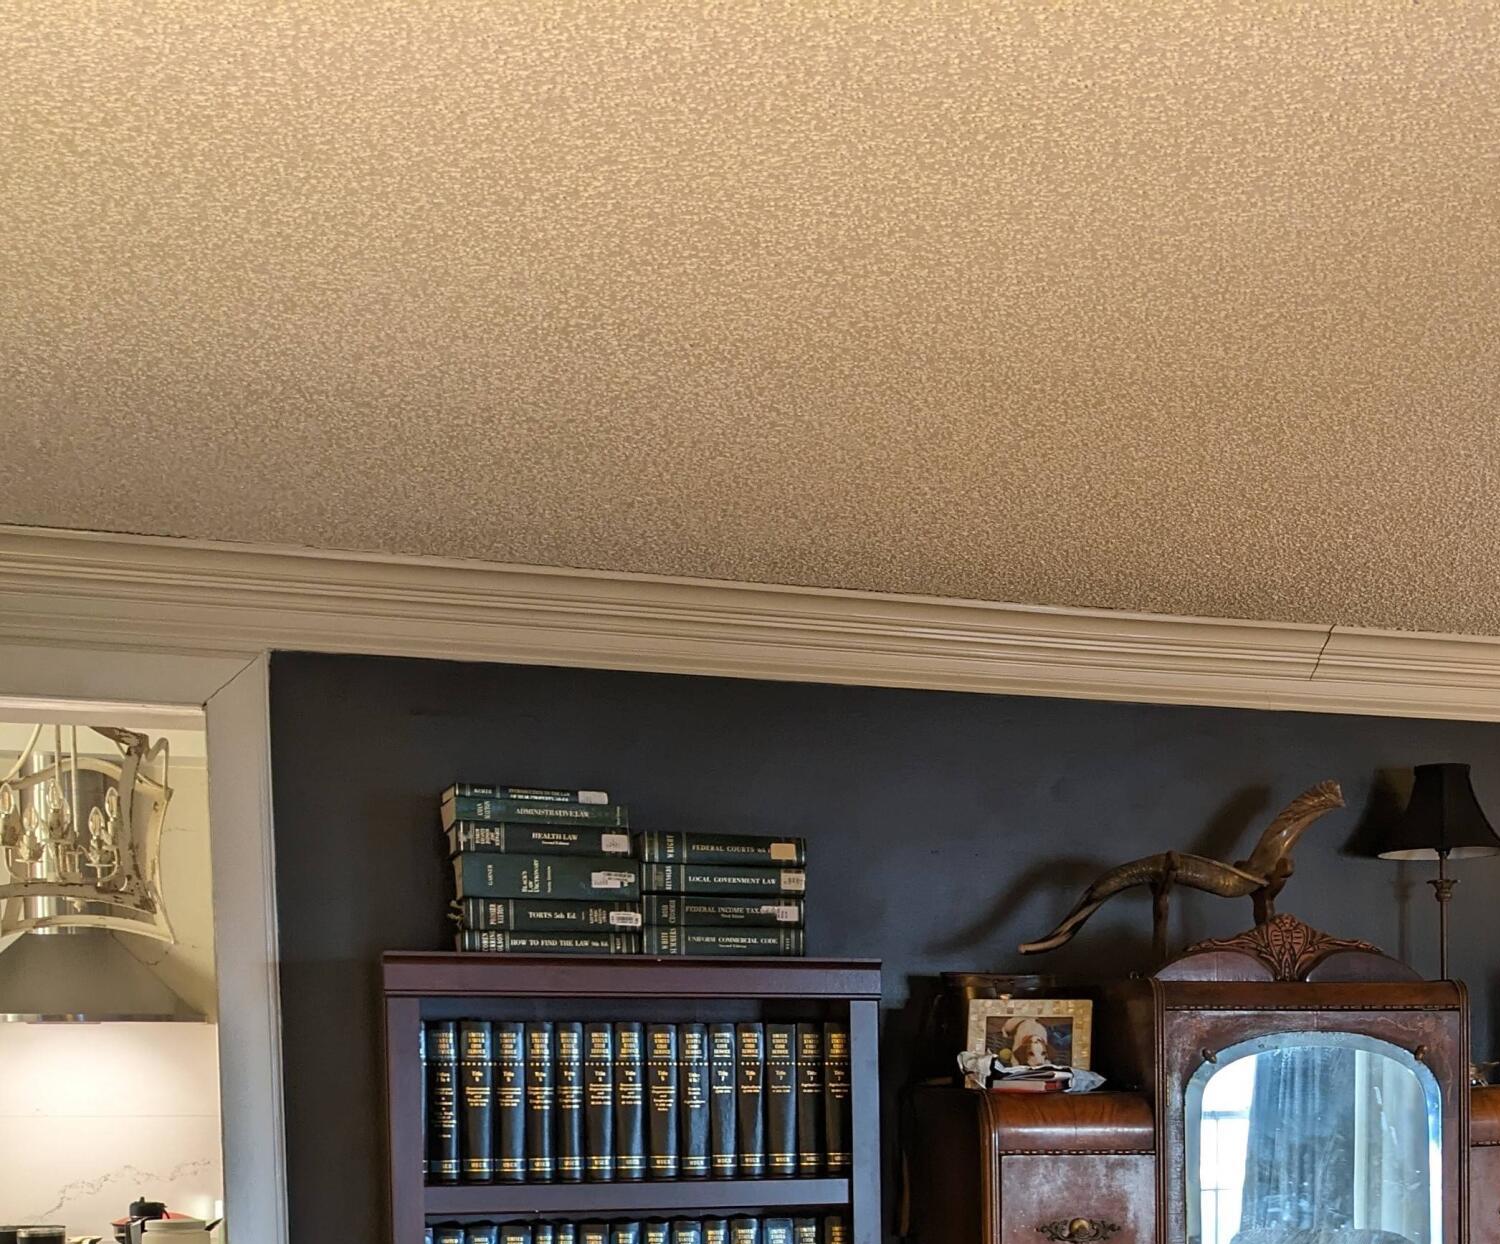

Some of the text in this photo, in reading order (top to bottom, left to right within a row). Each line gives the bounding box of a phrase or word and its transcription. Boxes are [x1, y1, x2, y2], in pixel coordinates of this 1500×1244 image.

[516, 808, 574, 817] ADMINISTRATIVE
[532, 832, 562, 840] HEALTH
[666, 835, 674, 858] WRIGHT
[692, 844, 724, 852] FEDERAL
[714, 876, 760, 884] GOVERNMENT
[528, 911, 552, 919] TORTS
[718, 936, 758, 944] COMMERCIAL
